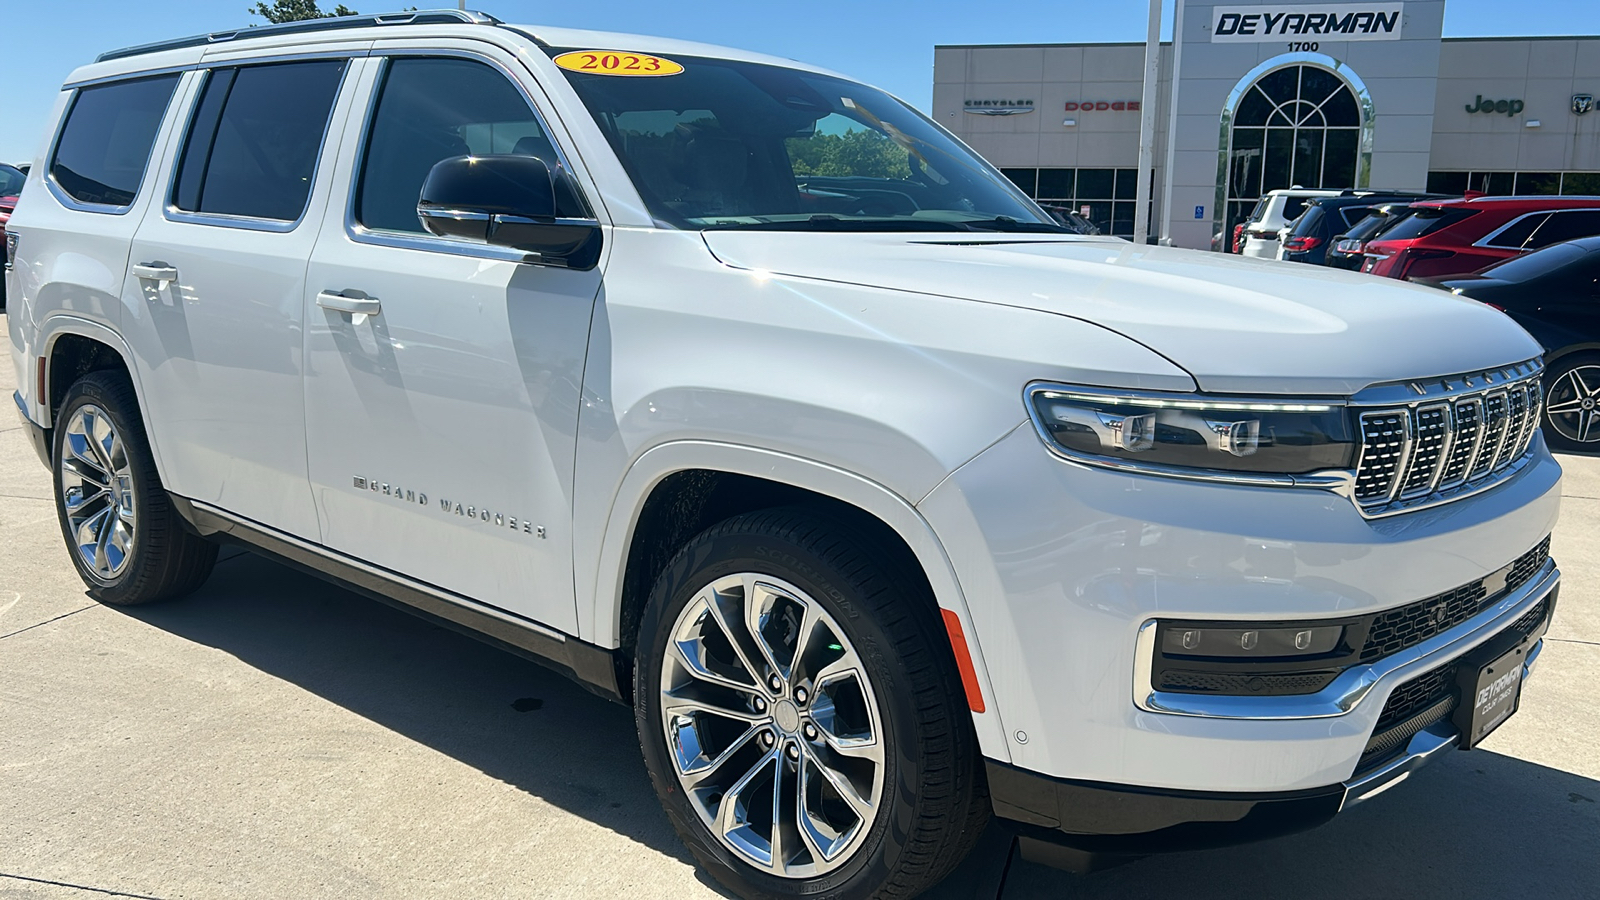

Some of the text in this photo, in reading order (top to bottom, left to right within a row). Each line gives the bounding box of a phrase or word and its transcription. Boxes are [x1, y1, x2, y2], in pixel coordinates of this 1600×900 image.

[1215, 11, 1400, 35] DEYARMAN
[1287, 42, 1319, 52] 1700
[580, 54, 661, 71] 2023
[1064, 101, 1140, 112] DODGE
[1465, 94, 1525, 118] Jeep
[370, 479, 547, 540] GRAND WAGONEER
[1475, 661, 1524, 709] DEYARMAN
